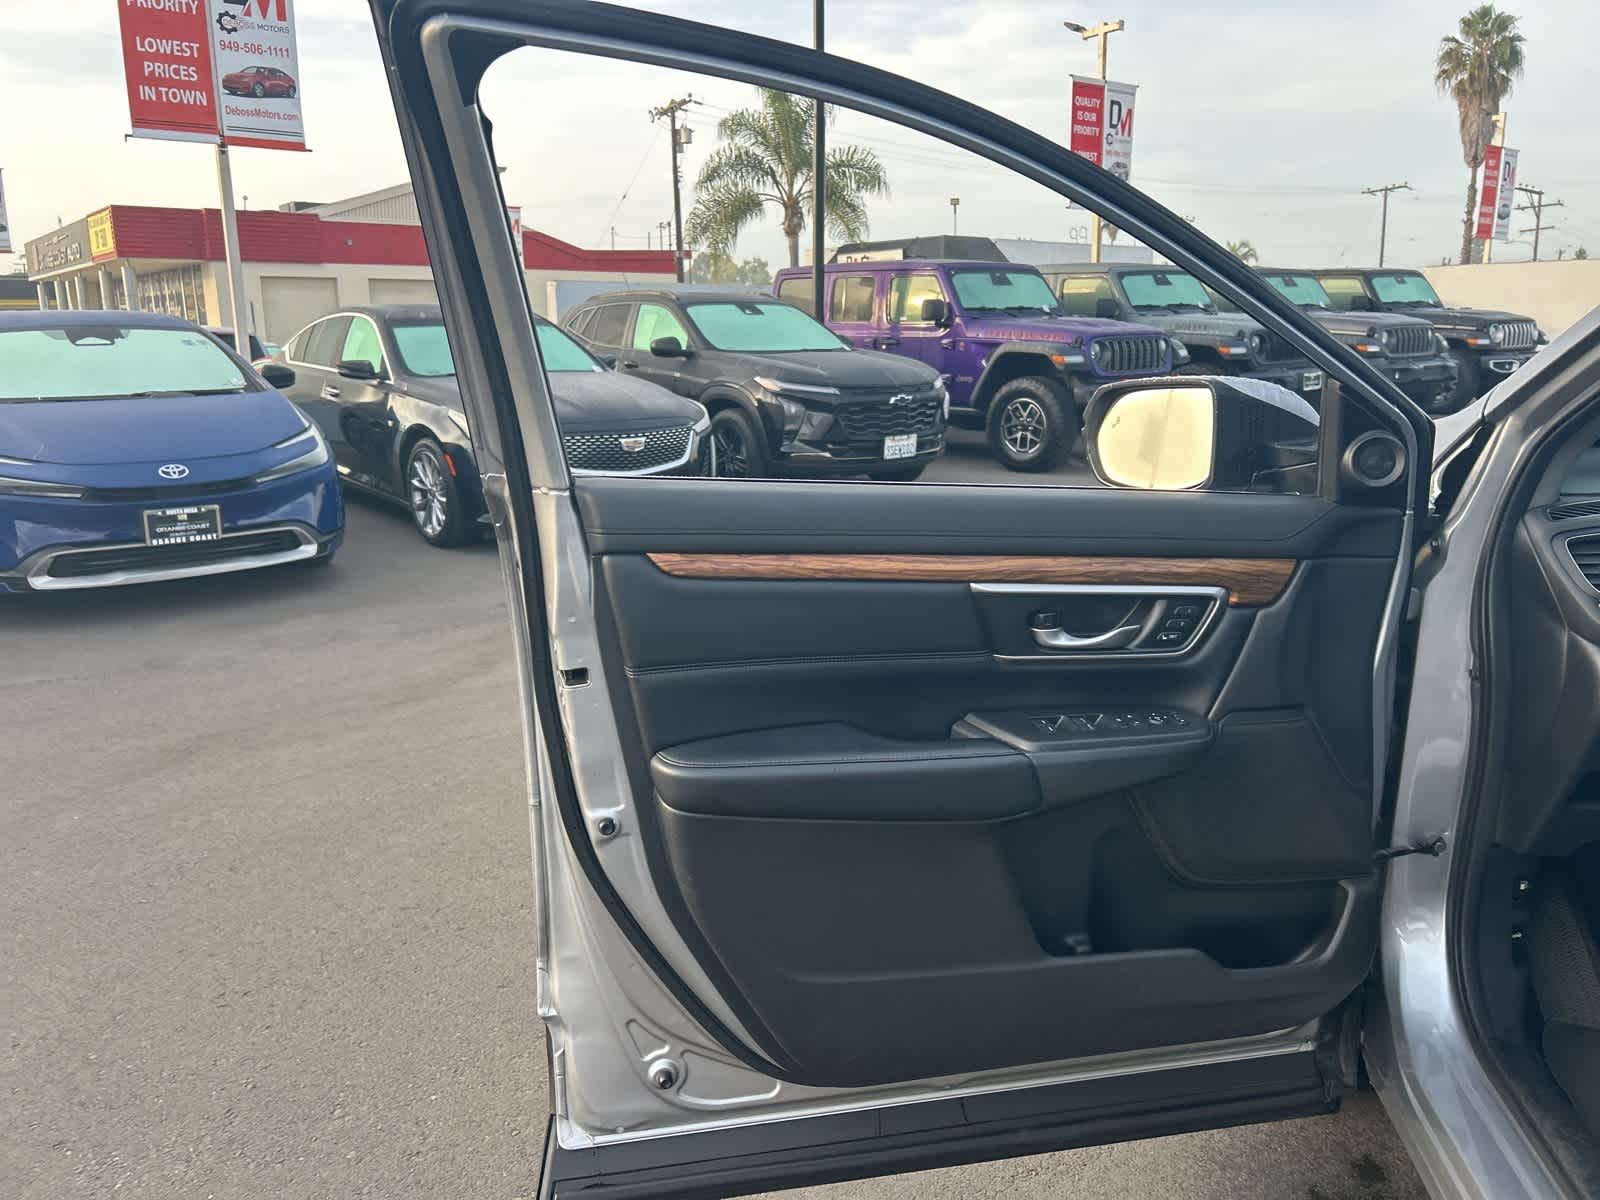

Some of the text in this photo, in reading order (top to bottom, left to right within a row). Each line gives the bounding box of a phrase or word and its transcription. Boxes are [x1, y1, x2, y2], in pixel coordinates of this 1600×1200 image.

[257, 23, 290, 34] MOTORS
[135, 36, 200, 58] LOWEST
[218, 39, 290, 58] 949-506-1111
[143, 61, 198, 81] PRICES
[138, 84, 208, 107] IN TOWN
[1075, 96, 1101, 108] QUALITY
[224, 104, 300, 121] DebossMotors.com
[1083, 111, 1097, 122] OUR
[1073, 124, 1100, 136] PRIORITY
[190, 533, 217, 541] COAST
